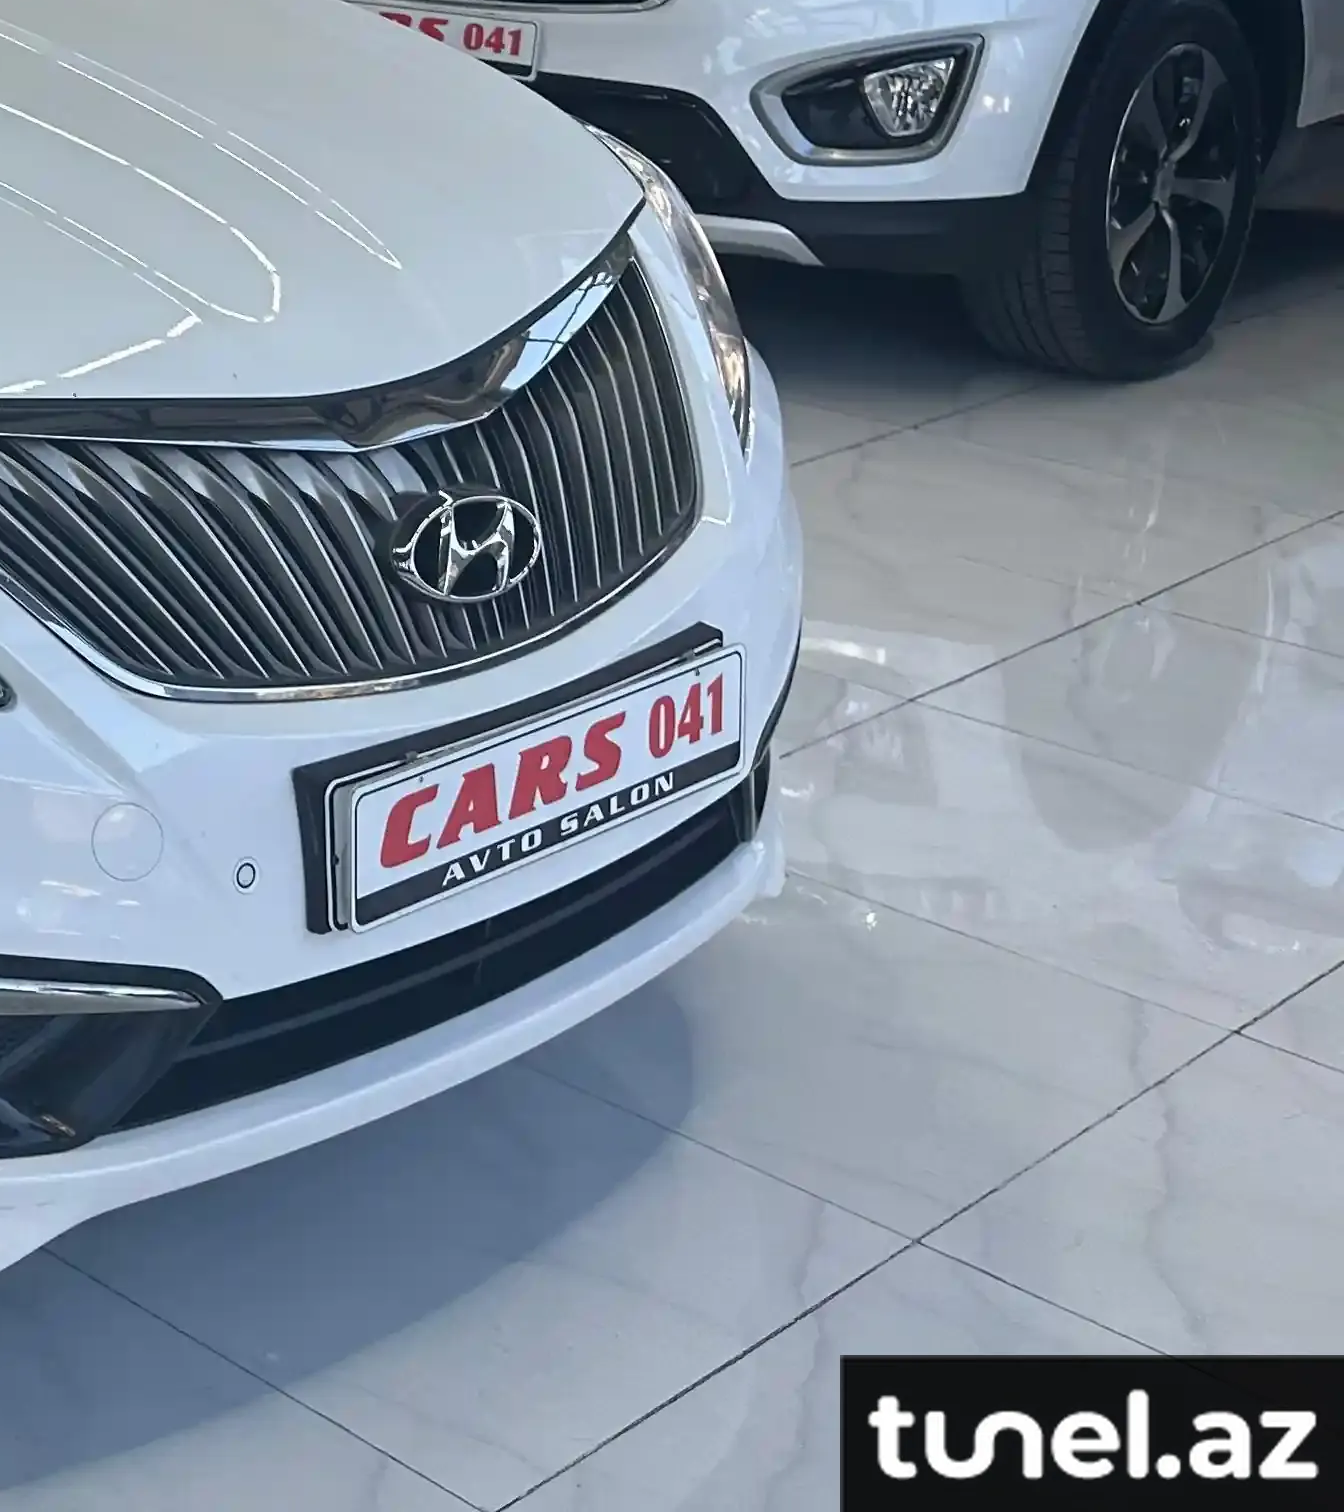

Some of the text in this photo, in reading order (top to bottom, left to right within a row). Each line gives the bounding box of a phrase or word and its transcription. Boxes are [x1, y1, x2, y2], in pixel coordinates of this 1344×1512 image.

[463, 23, 522, 56] 041
[380, 673, 723, 868] CARS 041
[442, 772, 674, 887] AVTO SALON
